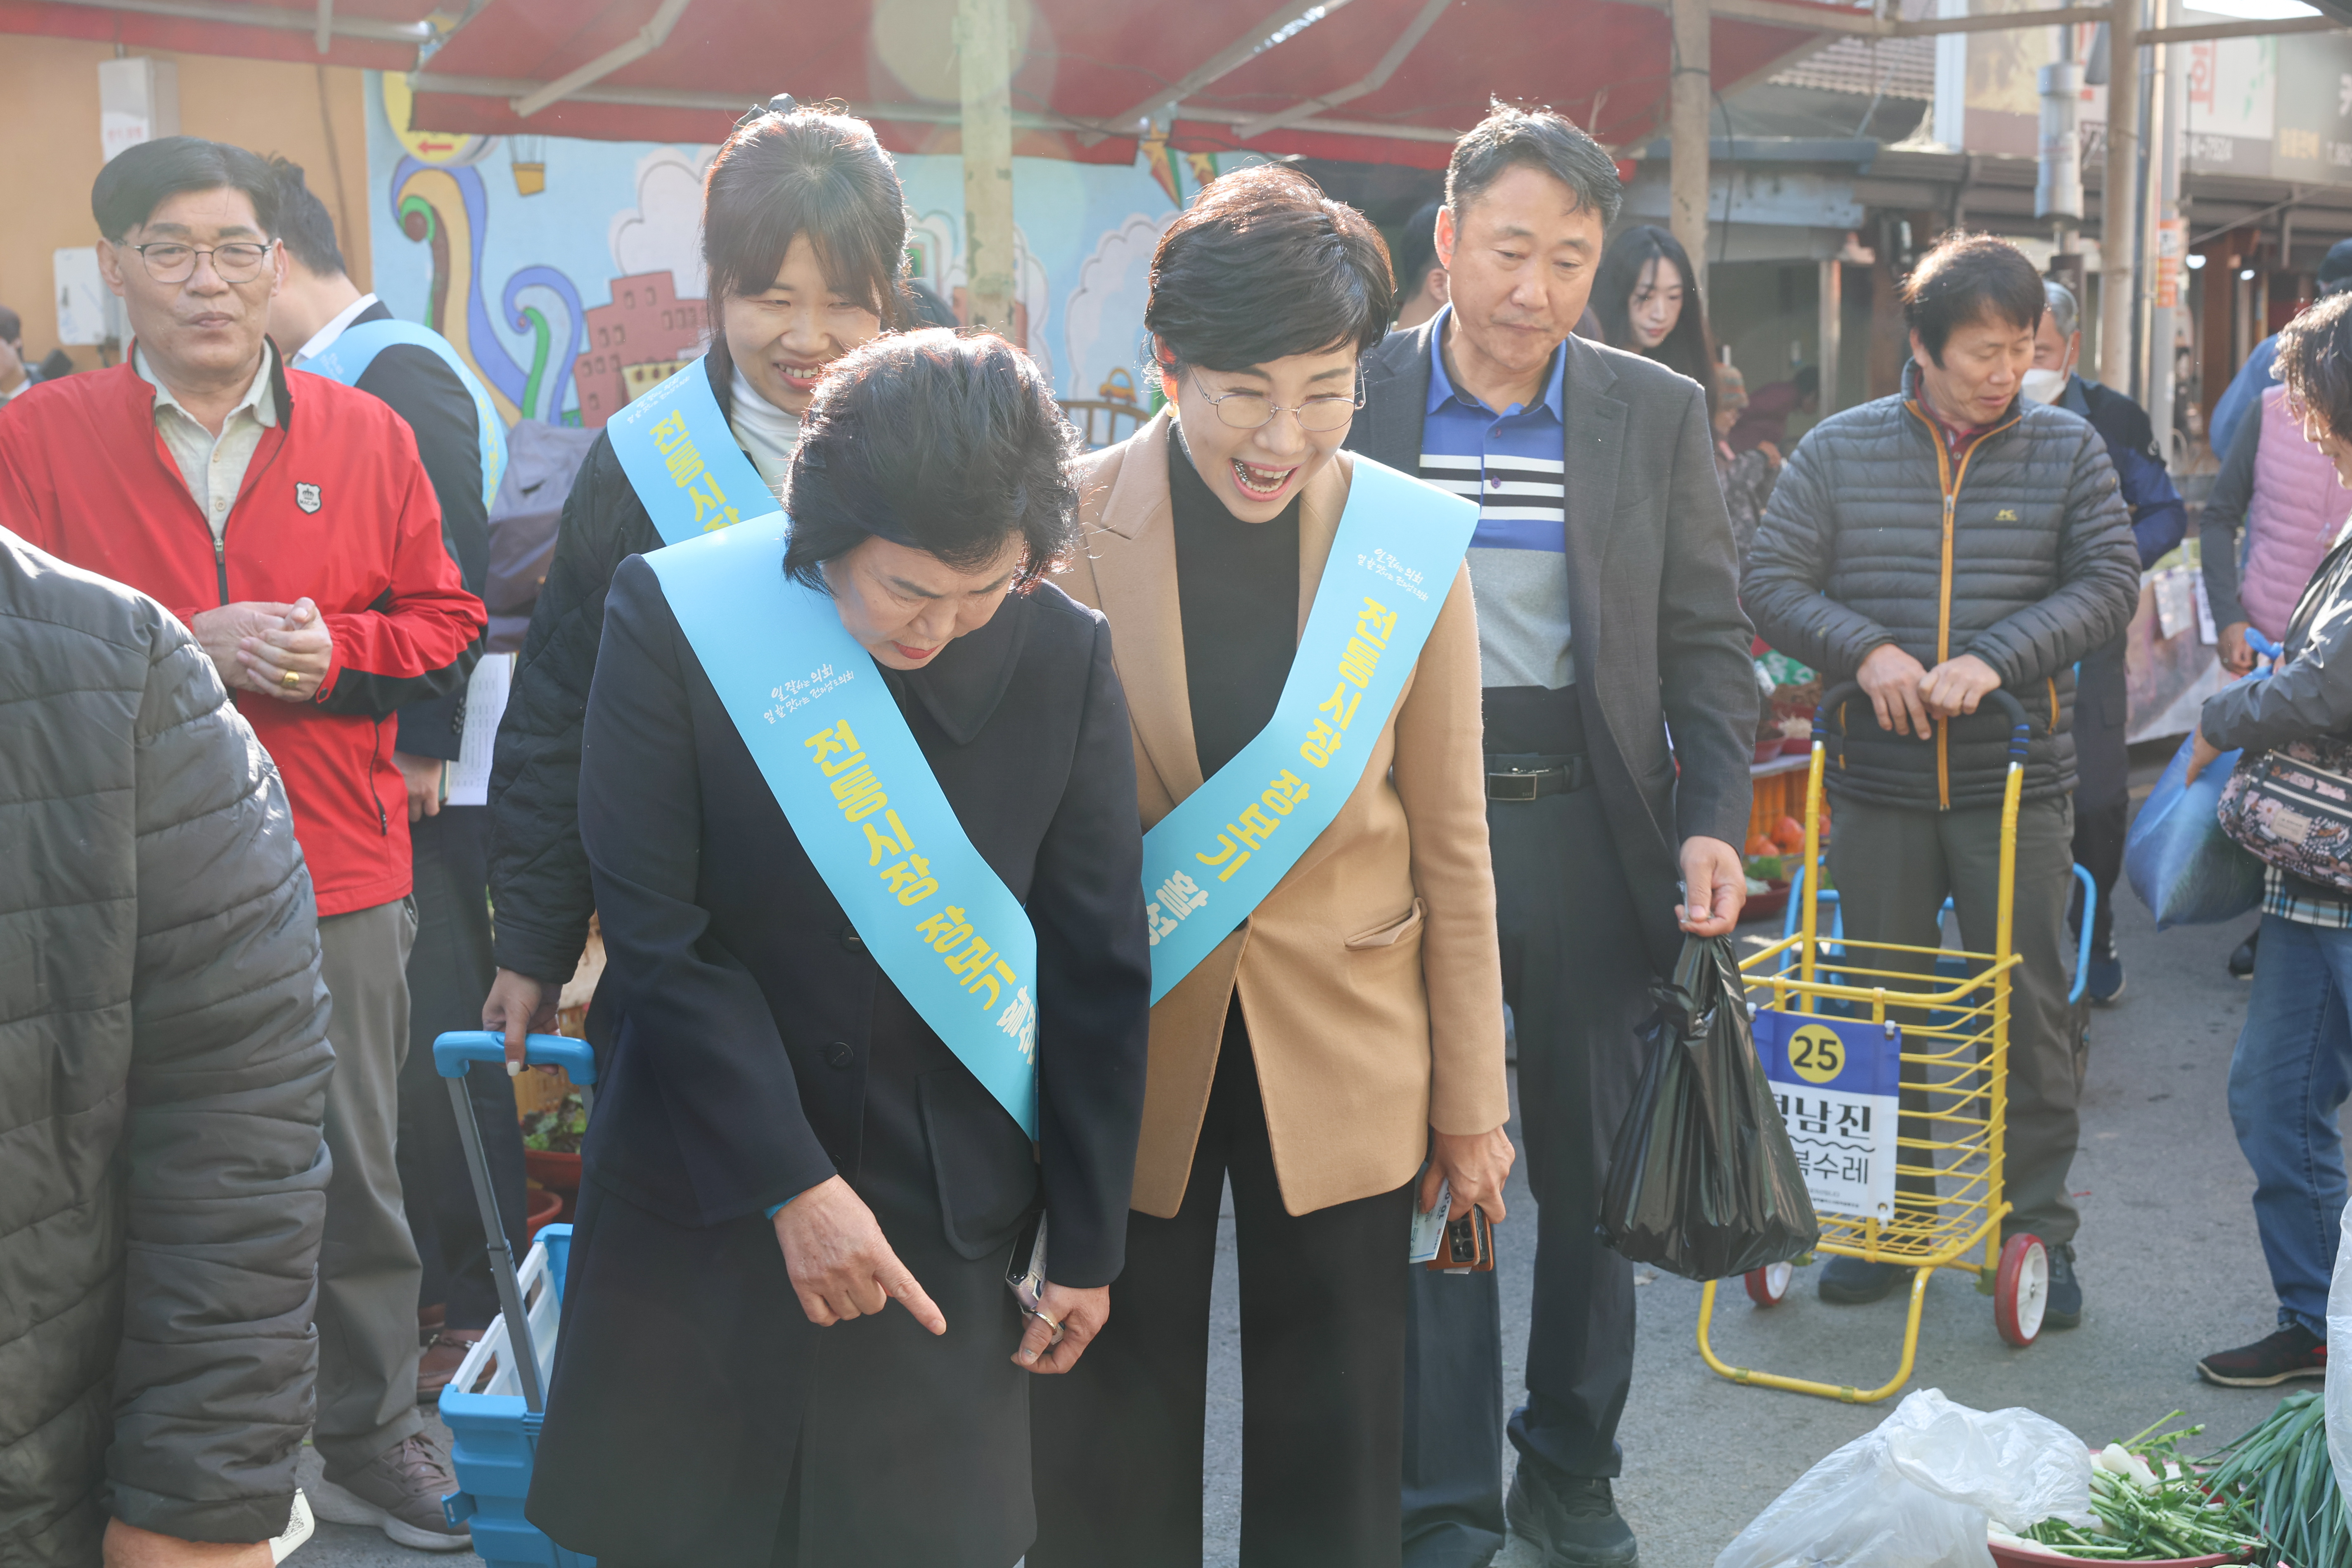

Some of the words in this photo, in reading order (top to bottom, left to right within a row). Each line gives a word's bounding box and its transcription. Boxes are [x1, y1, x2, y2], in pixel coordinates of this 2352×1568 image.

[1374, 549, 1386, 563] 일
[1405, 568, 1424, 585] 의회
[1396, 576, 1428, 602] 전라남도의회
[764, 709, 776, 724] 일
[810, 670, 854, 699] 전라남도의회
[771, 685, 789, 702] 일
[785, 680, 810, 694] 잘하는
[811, 663, 834, 683] 의회
[1300, 597, 1397, 768] 전통시장
[1196, 769, 1310, 882] 장보기
[804, 719, 939, 906] 전통시장
[915, 905, 1016, 1010] 장보기
[1794, 1036, 1838, 1071] 25
